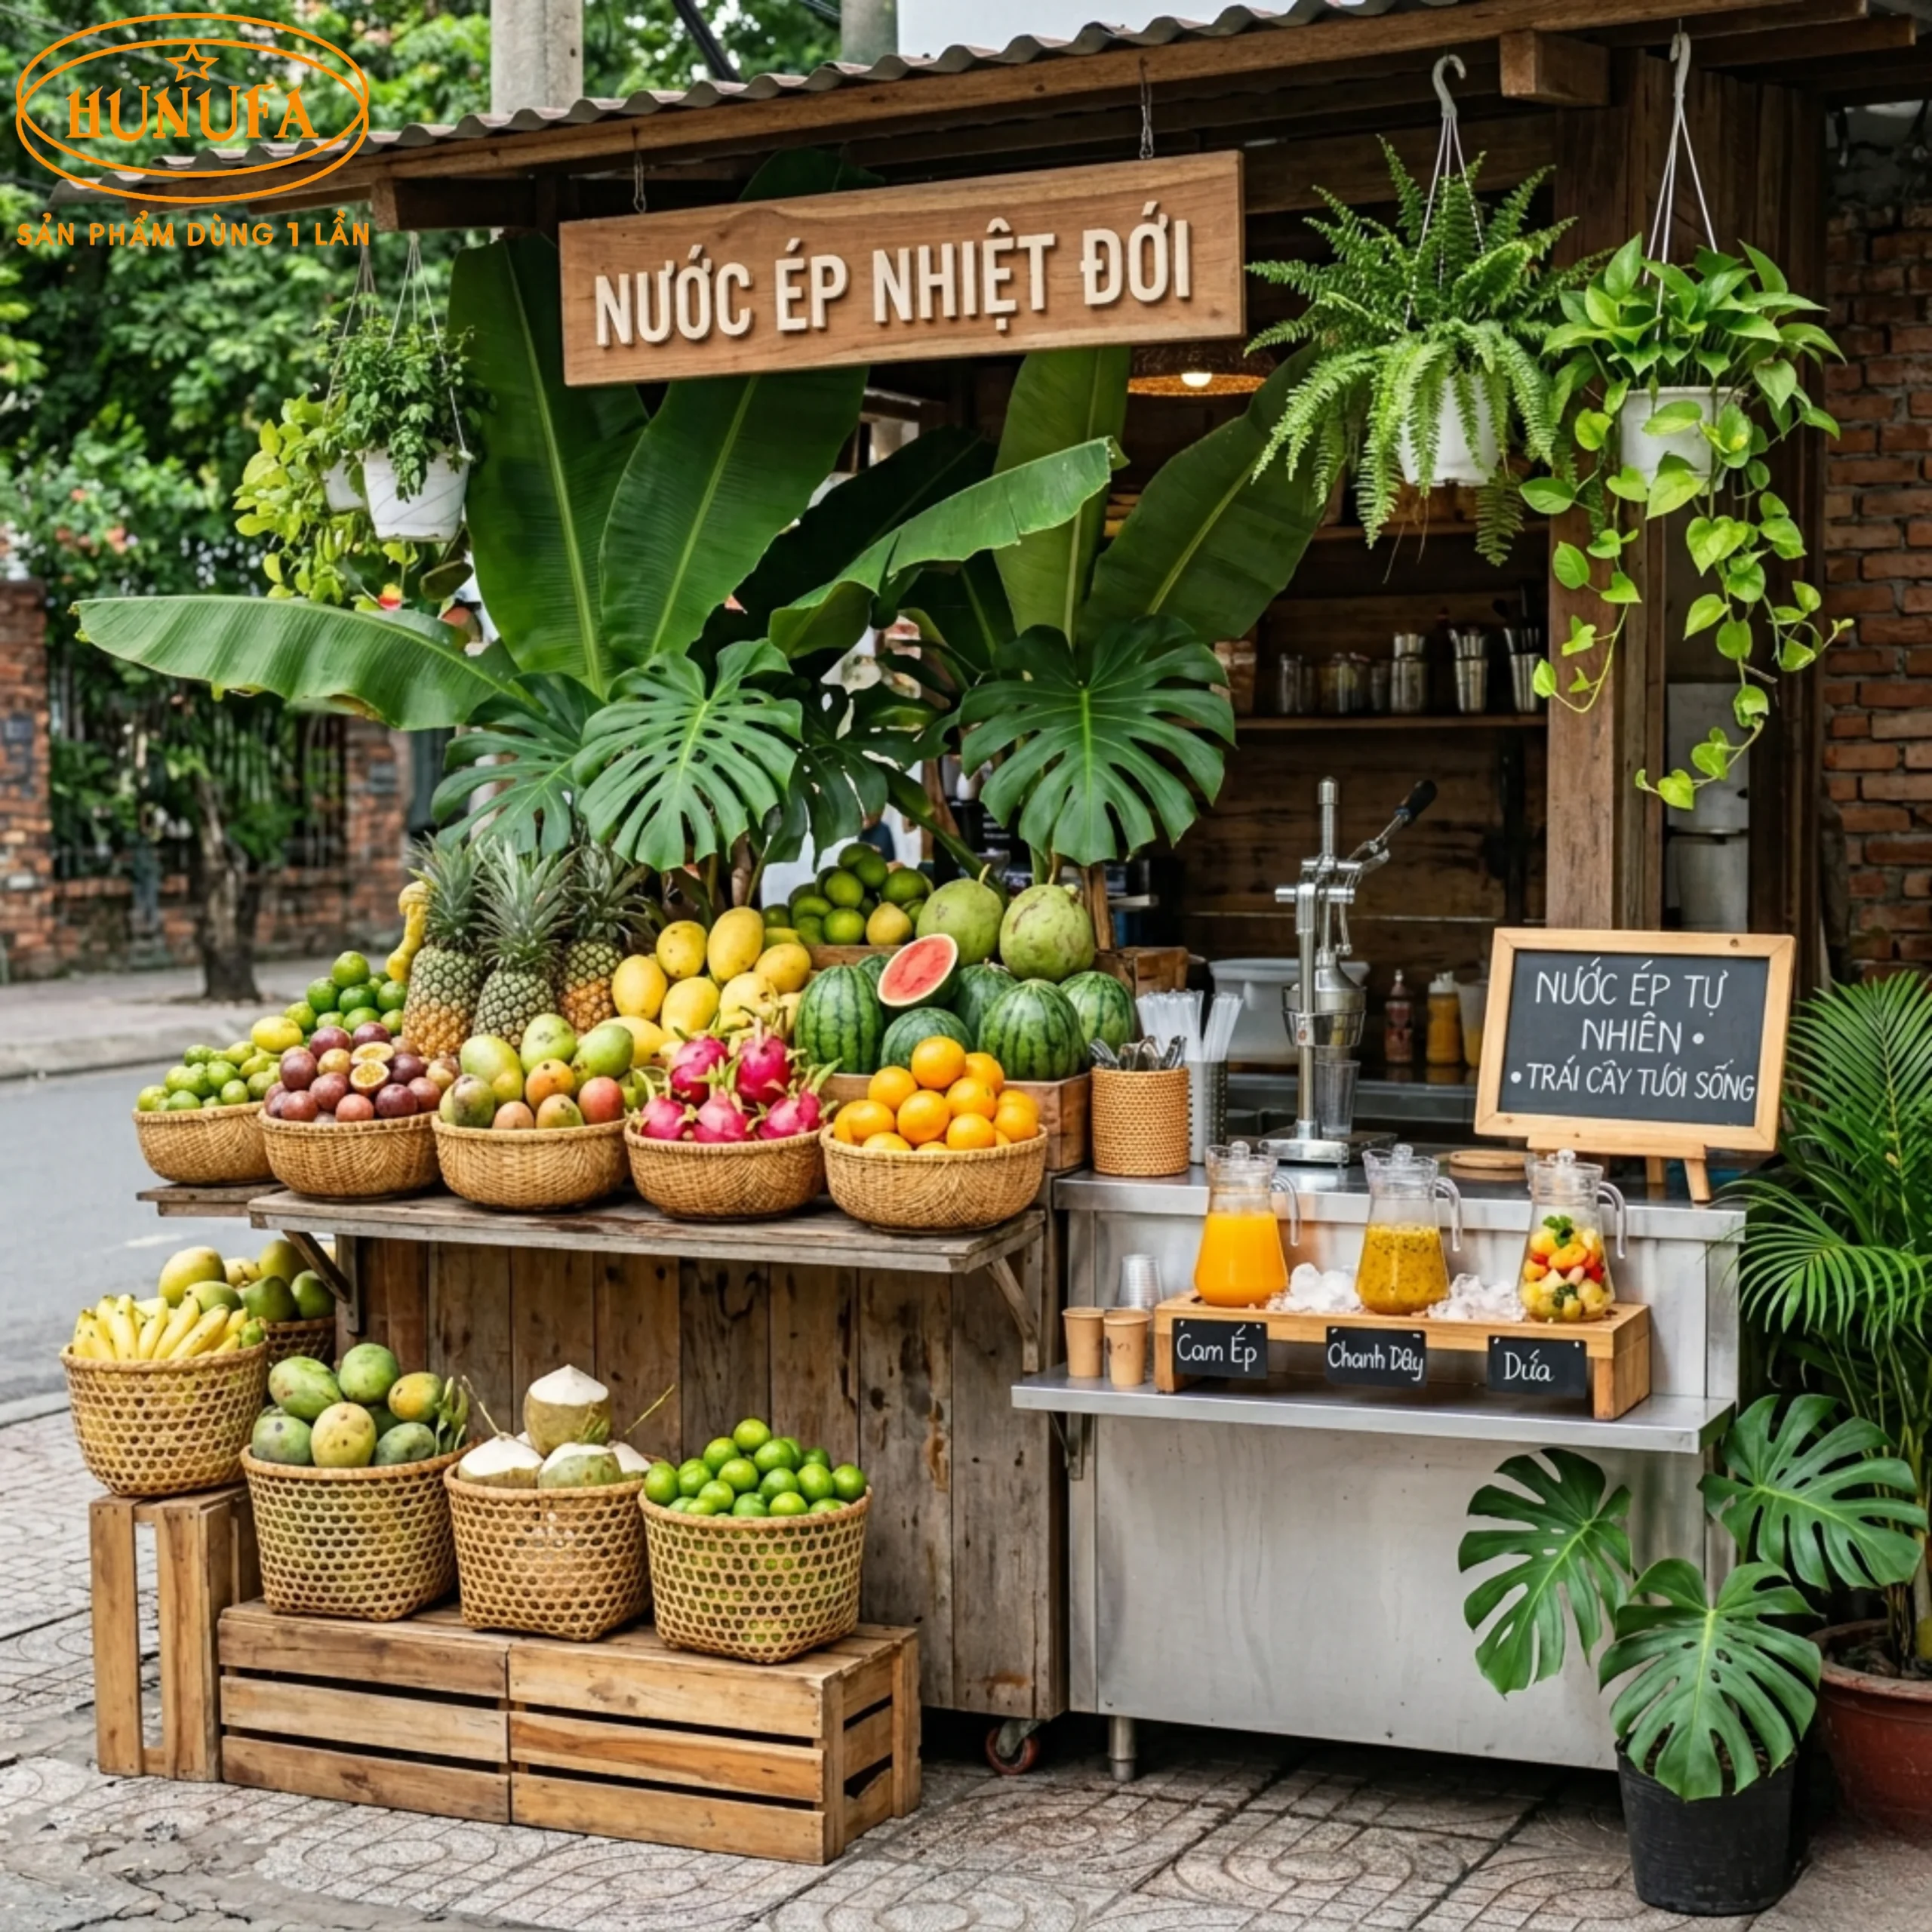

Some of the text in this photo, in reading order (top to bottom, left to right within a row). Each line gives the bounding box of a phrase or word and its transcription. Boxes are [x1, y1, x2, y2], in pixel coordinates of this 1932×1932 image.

[596, 201, 1191, 346] NƯỚC ÉP NHIỆT ĐỚI
[1535, 956, 1729, 1017] NƯỚC ÉP TỰ
[1581, 1011, 1682, 1055] NHIÊN
[1526, 1054, 1755, 1103] TRÁI CÂY TƯƠI SỐNG
[1177, 1324, 1257, 1372] Cam Ép
[1327, 1340, 1386, 1370] Chanh
[1503, 1348, 1555, 1382] Dứa
